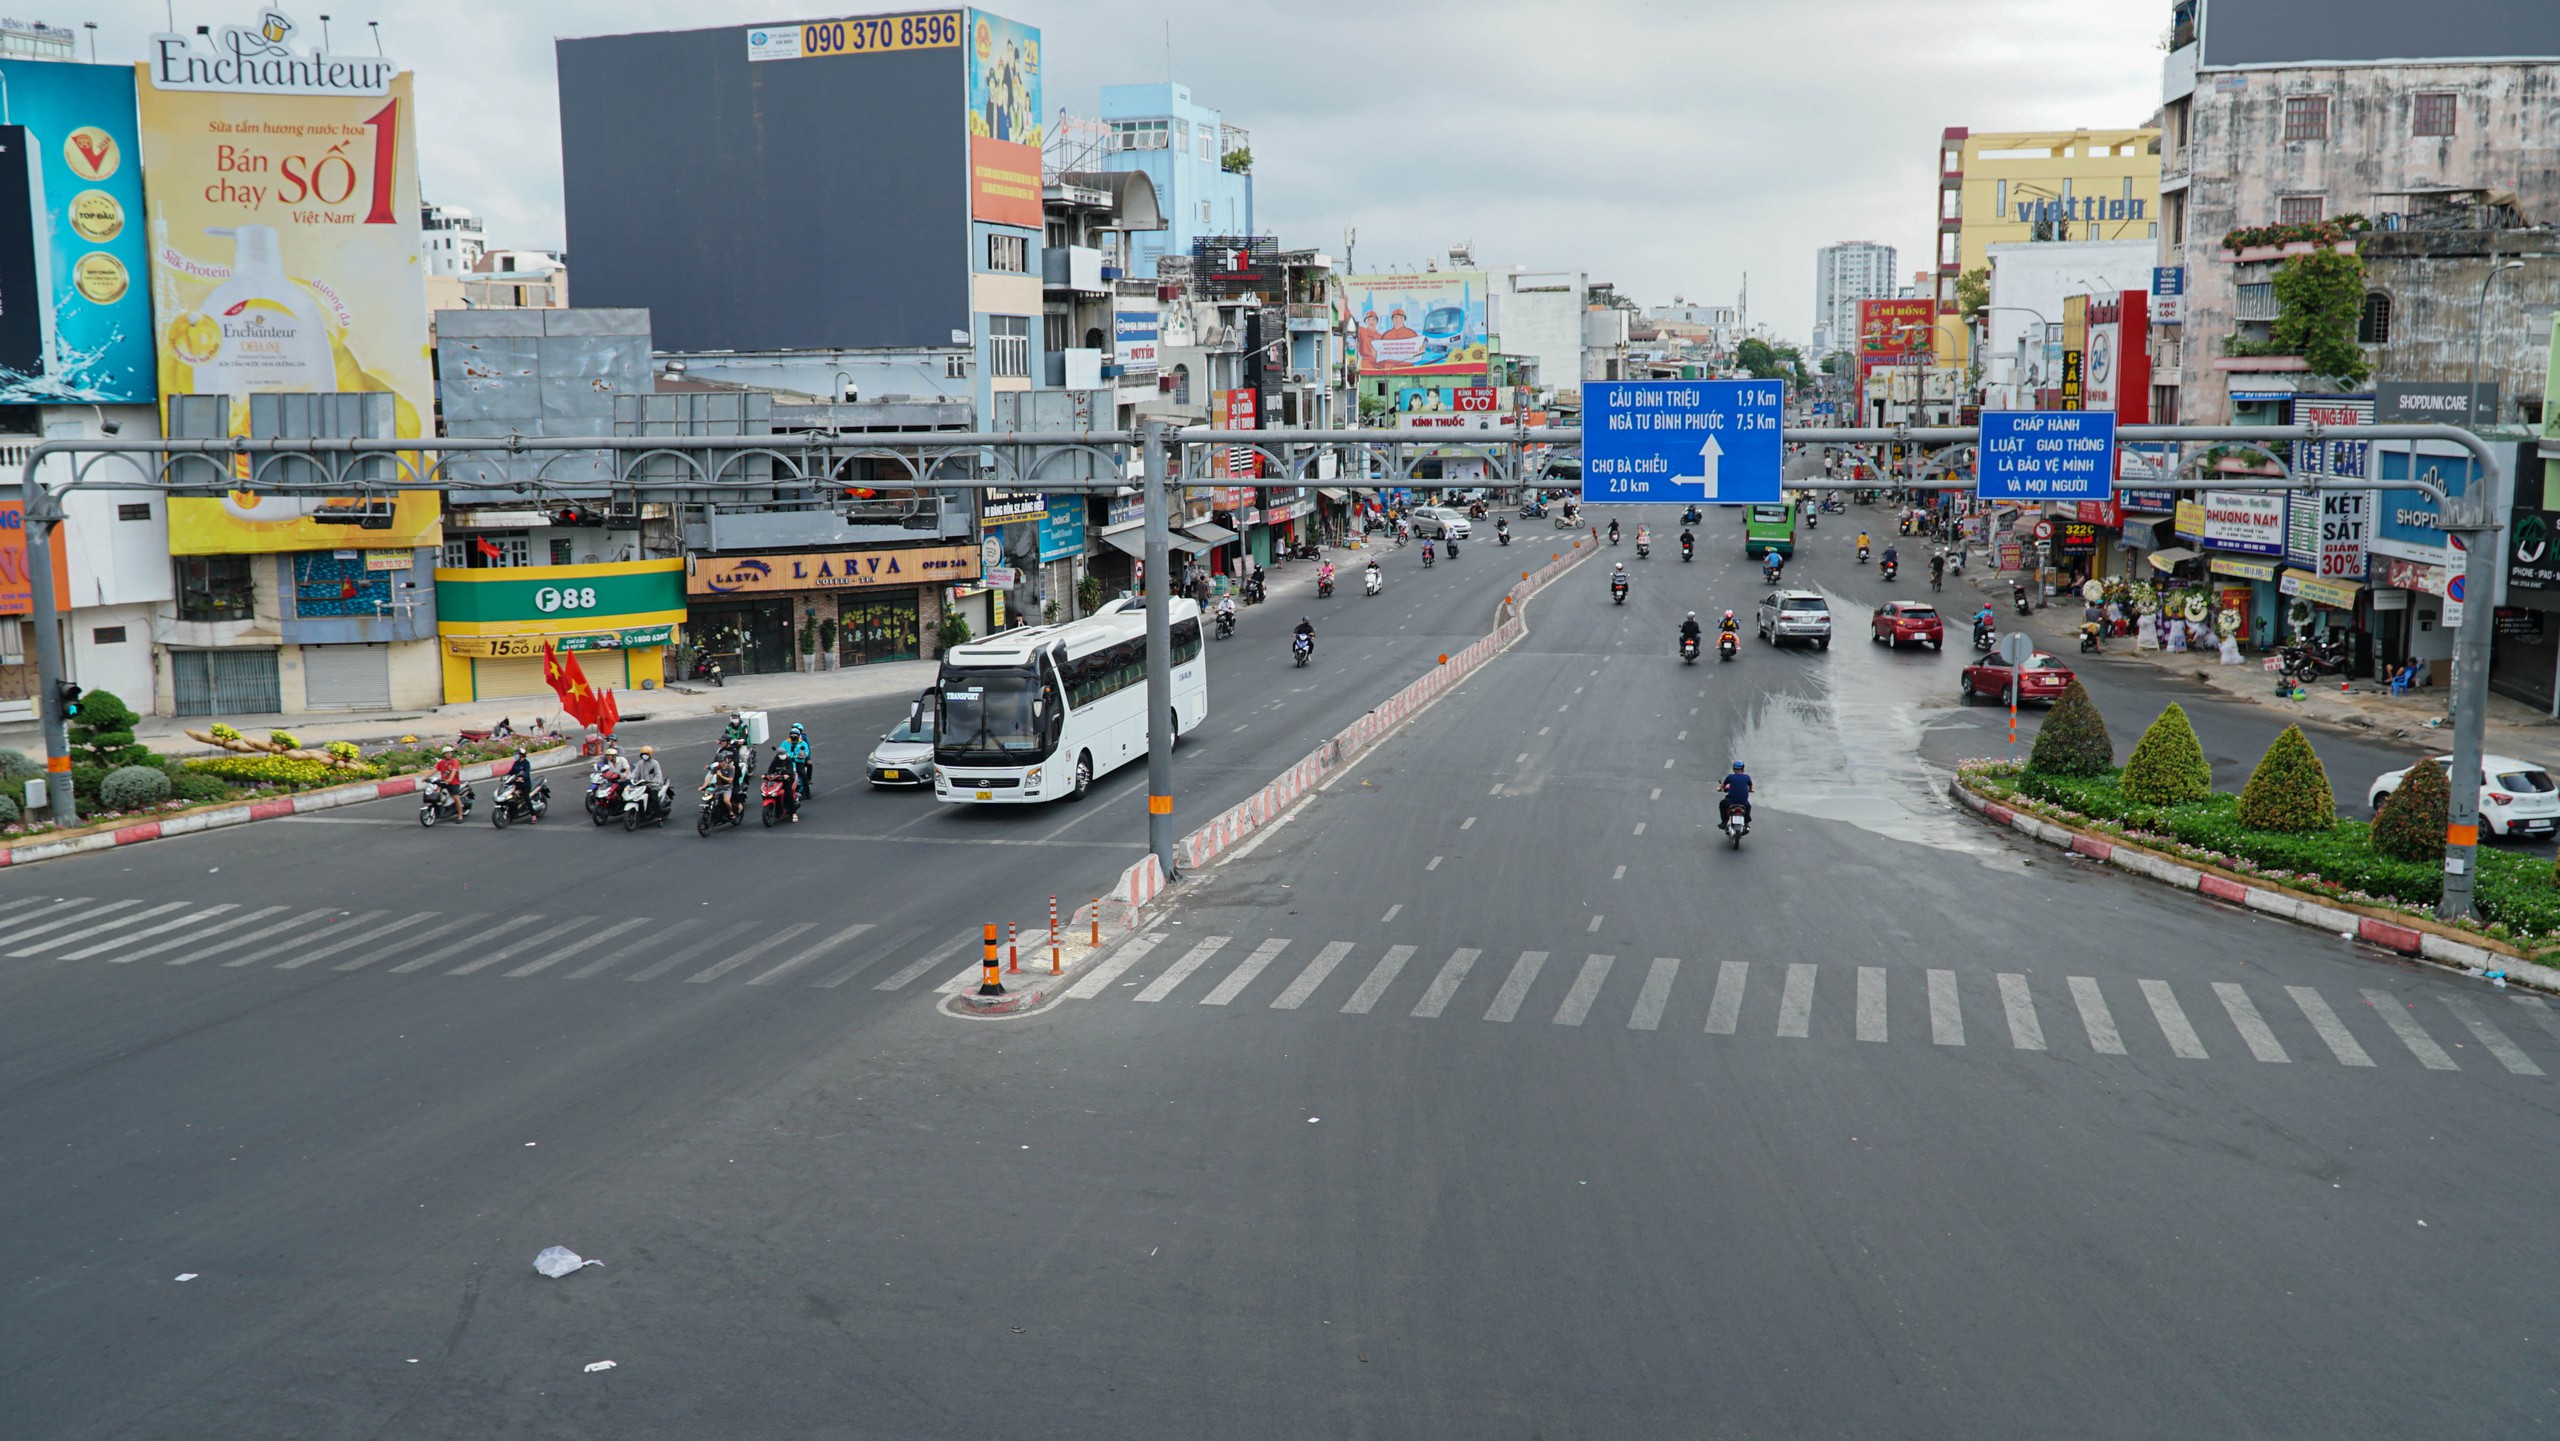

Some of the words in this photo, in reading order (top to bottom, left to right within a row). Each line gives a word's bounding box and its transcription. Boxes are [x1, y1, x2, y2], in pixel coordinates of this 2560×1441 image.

[806, 23, 845, 53] 090
[853, 20, 893, 49] 370
[901, 15, 956, 46] 8596
[158, 30, 392, 89] Enchanteur
[341, 124, 365, 135] hoa
[217, 144, 268, 172] Bán
[278, 139, 356, 204] SỐ
[362, 96, 401, 224] 1
[205, 178, 267, 211] chạy
[292, 211, 321, 224] Việt
[324, 212, 356, 224] Nam
[185, 261, 231, 278] Protein
[223, 320, 297, 339] Enchanteur
[1458, 388, 1472, 397] KÍNH
[1475, 387, 1494, 397] THUỐC
[1609, 385, 1632, 408] CẦU
[1635, 387, 1662, 407] BÌNH
[1667, 388, 1700, 408] TRIỆU
[1757, 390, 1776, 406] Km
[2399, 395, 2444, 411] SHOPDUNK
[2445, 395, 2468, 411] CARE
[1412, 416, 1433, 427] KÍNH
[1435, 415, 1465, 427] THUỐC
[1609, 411, 1632, 430] NGÃ
[1635, 413, 1651, 430] TƯ
[1654, 410, 1681, 430] BÌNH
[1685, 409, 1724, 430] PHƯỚC
[1757, 414, 1776, 429] Km
[2013, 415, 2044, 431] CHẤP
[2047, 415, 2080, 431] HÀNH
[1990, 436, 2025, 454] LUẬT
[2036, 438, 2063, 452] GIAO
[2067, 436, 2105, 452] THÔNG
[1592, 458, 1614, 474] CHỢ
[1617, 456, 1632, 473] BÀ
[1635, 453, 1668, 473] CHIỂU
[1998, 456, 2014, 472] LÀ
[2017, 455, 2040, 472] BẢO
[2044, 456, 2060, 474] VỆ
[2063, 455, 2094, 472] MÌNH
[1630, 478, 1649, 492] km
[2007, 475, 2021, 492] VÀ
[2025, 478, 2047, 494] MỌI
[2052, 475, 2088, 492] NGƯỜI
[2325, 492, 2363, 515] KÉT
[2253, 513, 2279, 527] NAM
[2323, 515, 2363, 541] SẮT
[2396, 508, 2439, 529] SHOPD
[793, 556, 901, 579] LARVA
[922, 560, 948, 570] OPEN
[2321, 553, 2360, 575] 30%
[2512, 566, 2534, 578] IPHONE
[2538, 570, 2552, 580] IPAD
[716, 572, 760, 583] LARVA
[535, 587, 596, 612] F88
[490, 640, 510, 656] 15
[947, 692, 979, 700] TRANSPORT
